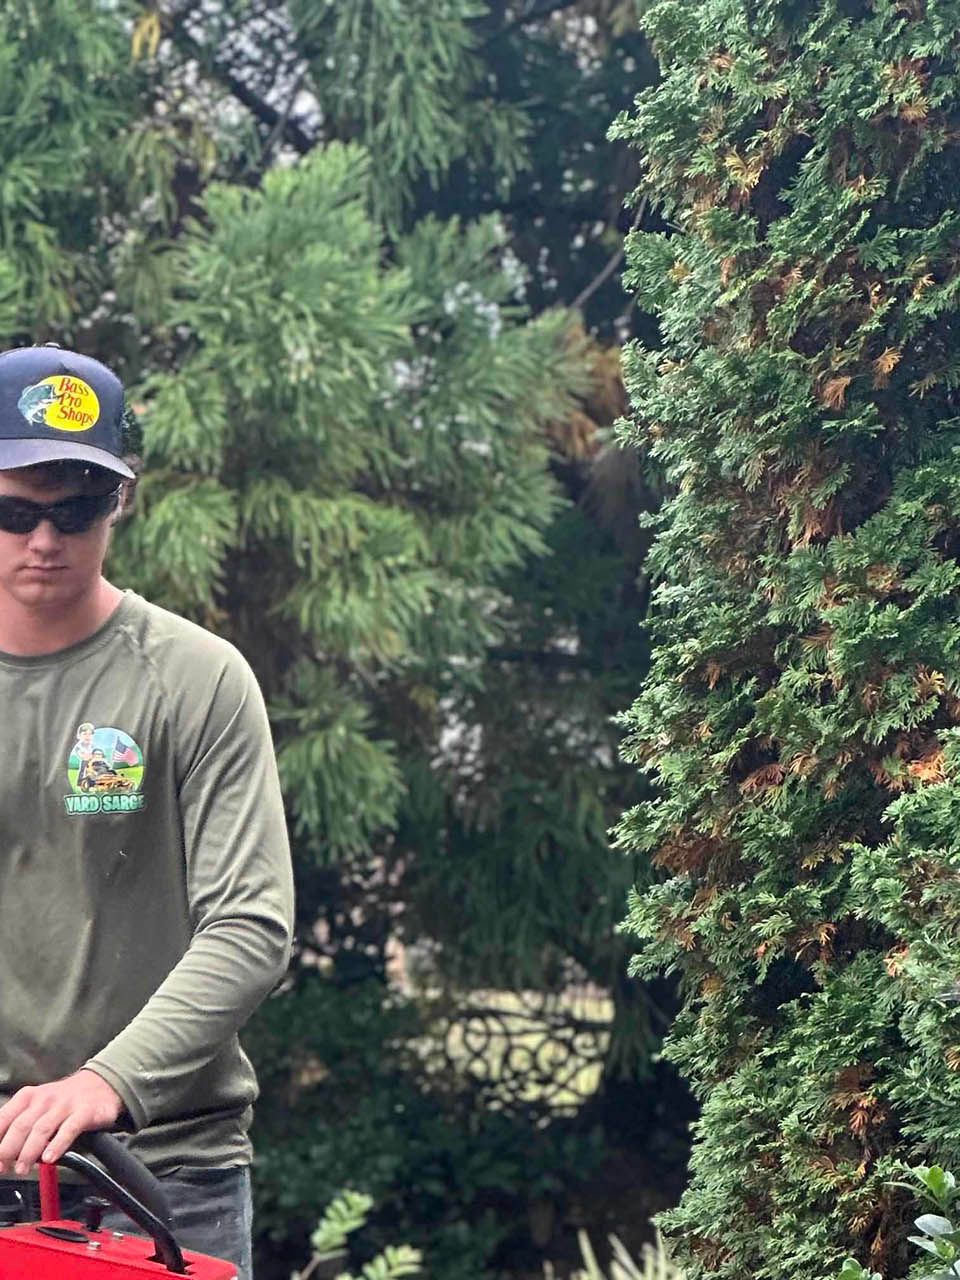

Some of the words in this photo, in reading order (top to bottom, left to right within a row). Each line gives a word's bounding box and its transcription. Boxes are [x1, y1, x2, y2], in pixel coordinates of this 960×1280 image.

[59, 377, 89, 397] Bass
[58, 393, 82, 408] Pro
[57, 405, 94, 426] Shops
[66, 795, 100, 812] YARD
[102, 794, 145, 811] SARGE
